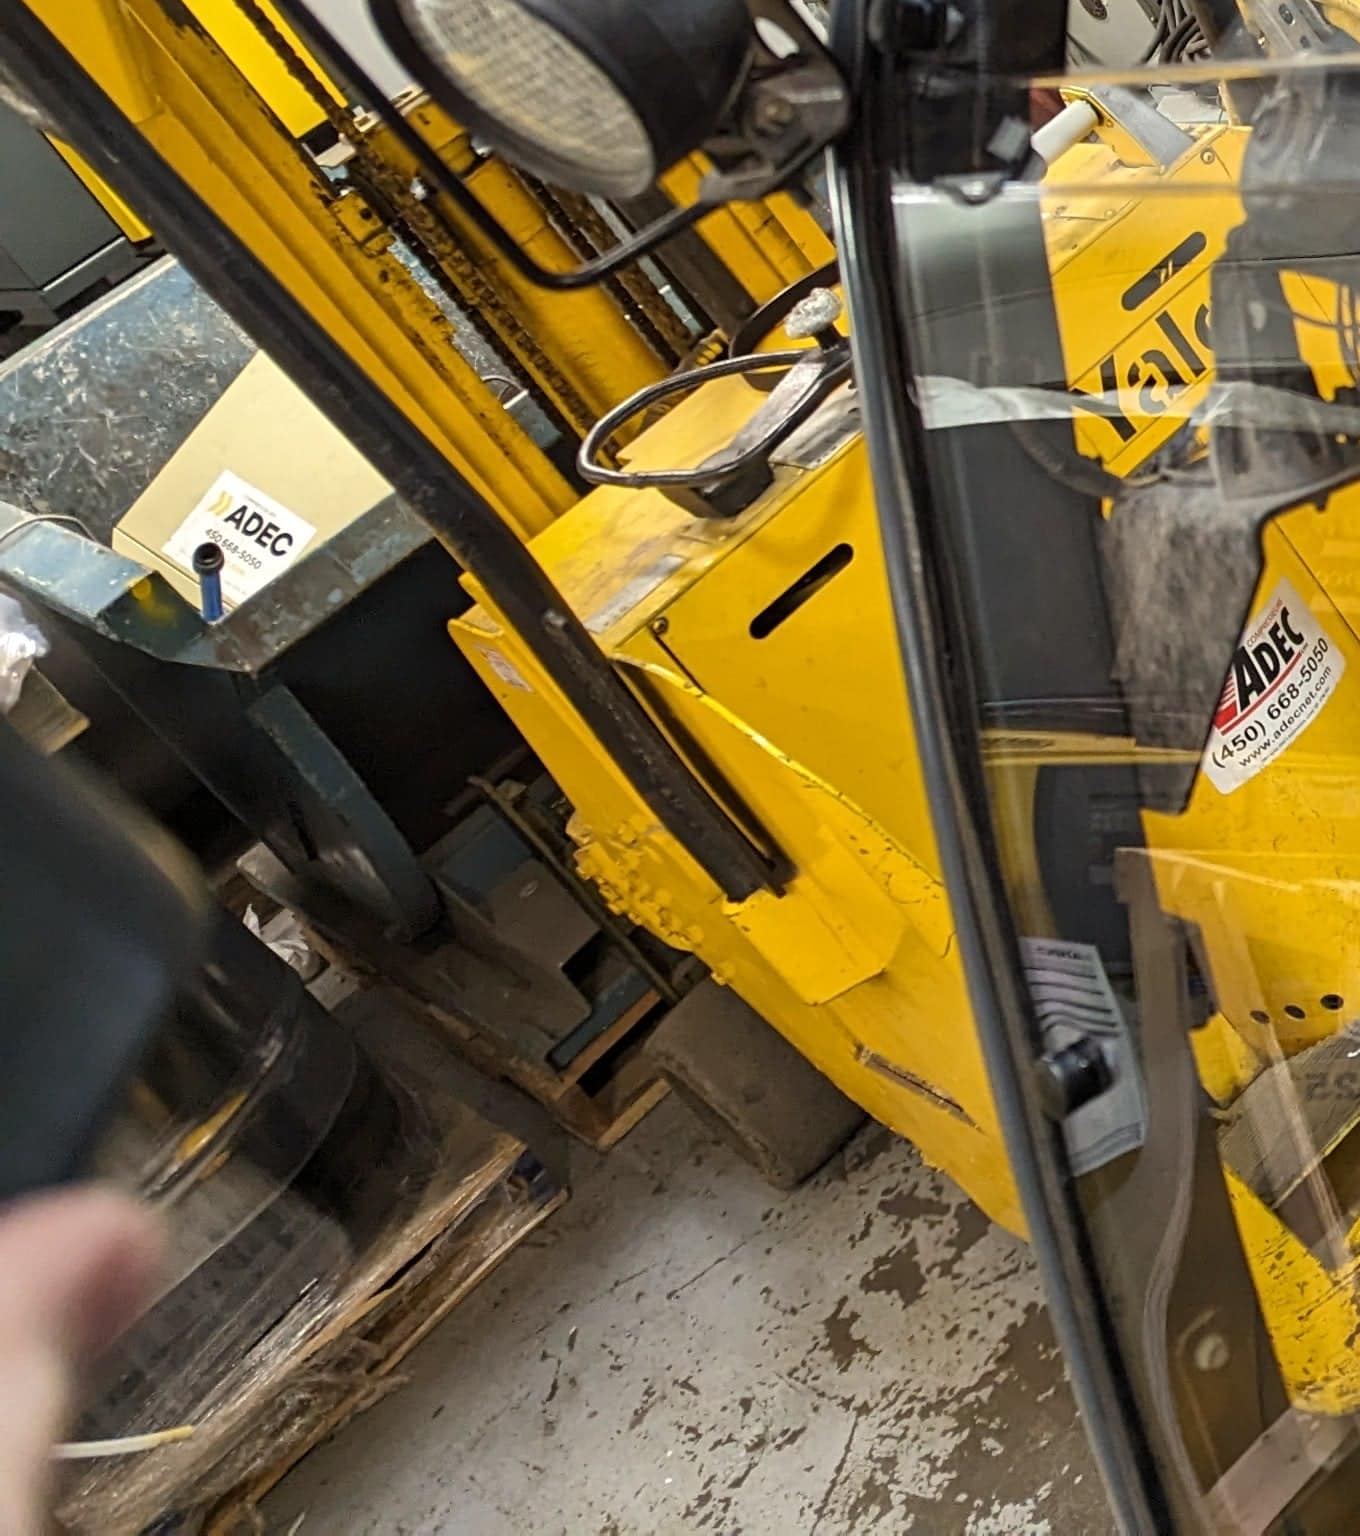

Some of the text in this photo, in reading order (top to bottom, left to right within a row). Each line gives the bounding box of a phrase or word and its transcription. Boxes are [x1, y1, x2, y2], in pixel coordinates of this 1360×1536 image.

[205, 528, 223, 544] 450
[221, 538, 262, 570] 668-5050
[223, 505, 293, 557] ADEC
[1211, 720, 1267, 769] (450)
[1267, 637, 1329, 721] 668-5050
[1231, 606, 1305, 713] ADEC
[1239, 665, 1332, 767] www.adecnet.com
